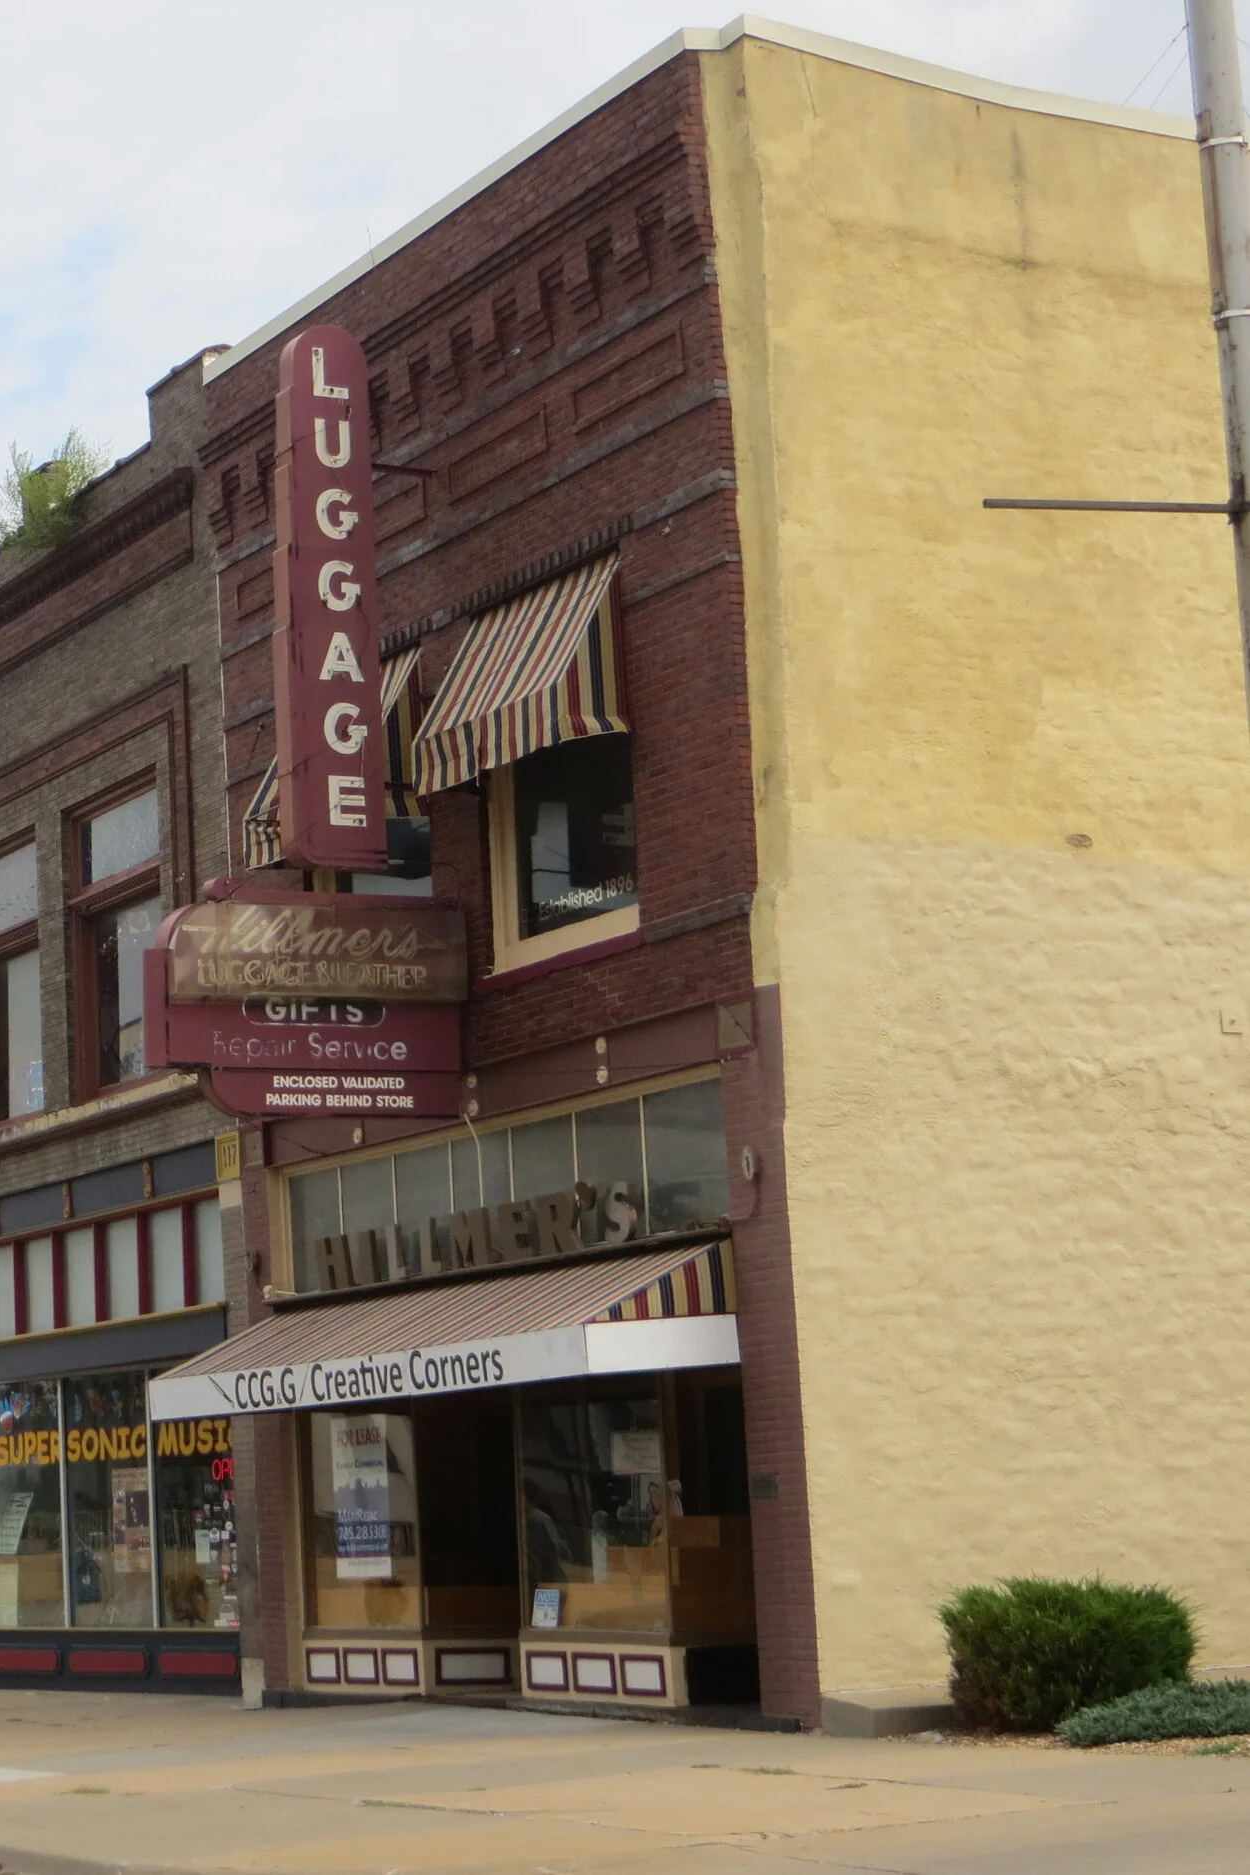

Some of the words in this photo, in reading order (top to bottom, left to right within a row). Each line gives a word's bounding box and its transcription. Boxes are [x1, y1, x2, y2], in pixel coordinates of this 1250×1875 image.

[310, 346, 368, 828] LUGGAGE
[539, 882, 602, 921] Established
[606, 873, 633, 898] 1896
[265, 1000, 364, 1022] GIFTS
[213, 1031, 296, 1063] Repair
[308, 1032, 408, 1061] Service
[272, 1076, 338, 1089] ENCLOSED
[341, 1076, 405, 1090] VALIDATED
[265, 1093, 322, 1107] PARKING
[326, 1094, 372, 1107] BEHIND
[376, 1094, 414, 1108] STORE
[223, 1142, 237, 1168] 117
[313, 1180, 638, 1290] HILLMER'S
[234, 1366, 297, 1410] CCG&G
[310, 1354, 403, 1402] Creative
[408, 1348, 504, 1391] Corners
[355, 1426, 381, 1446] LEASE
[211, 1459, 235, 1481] OP
